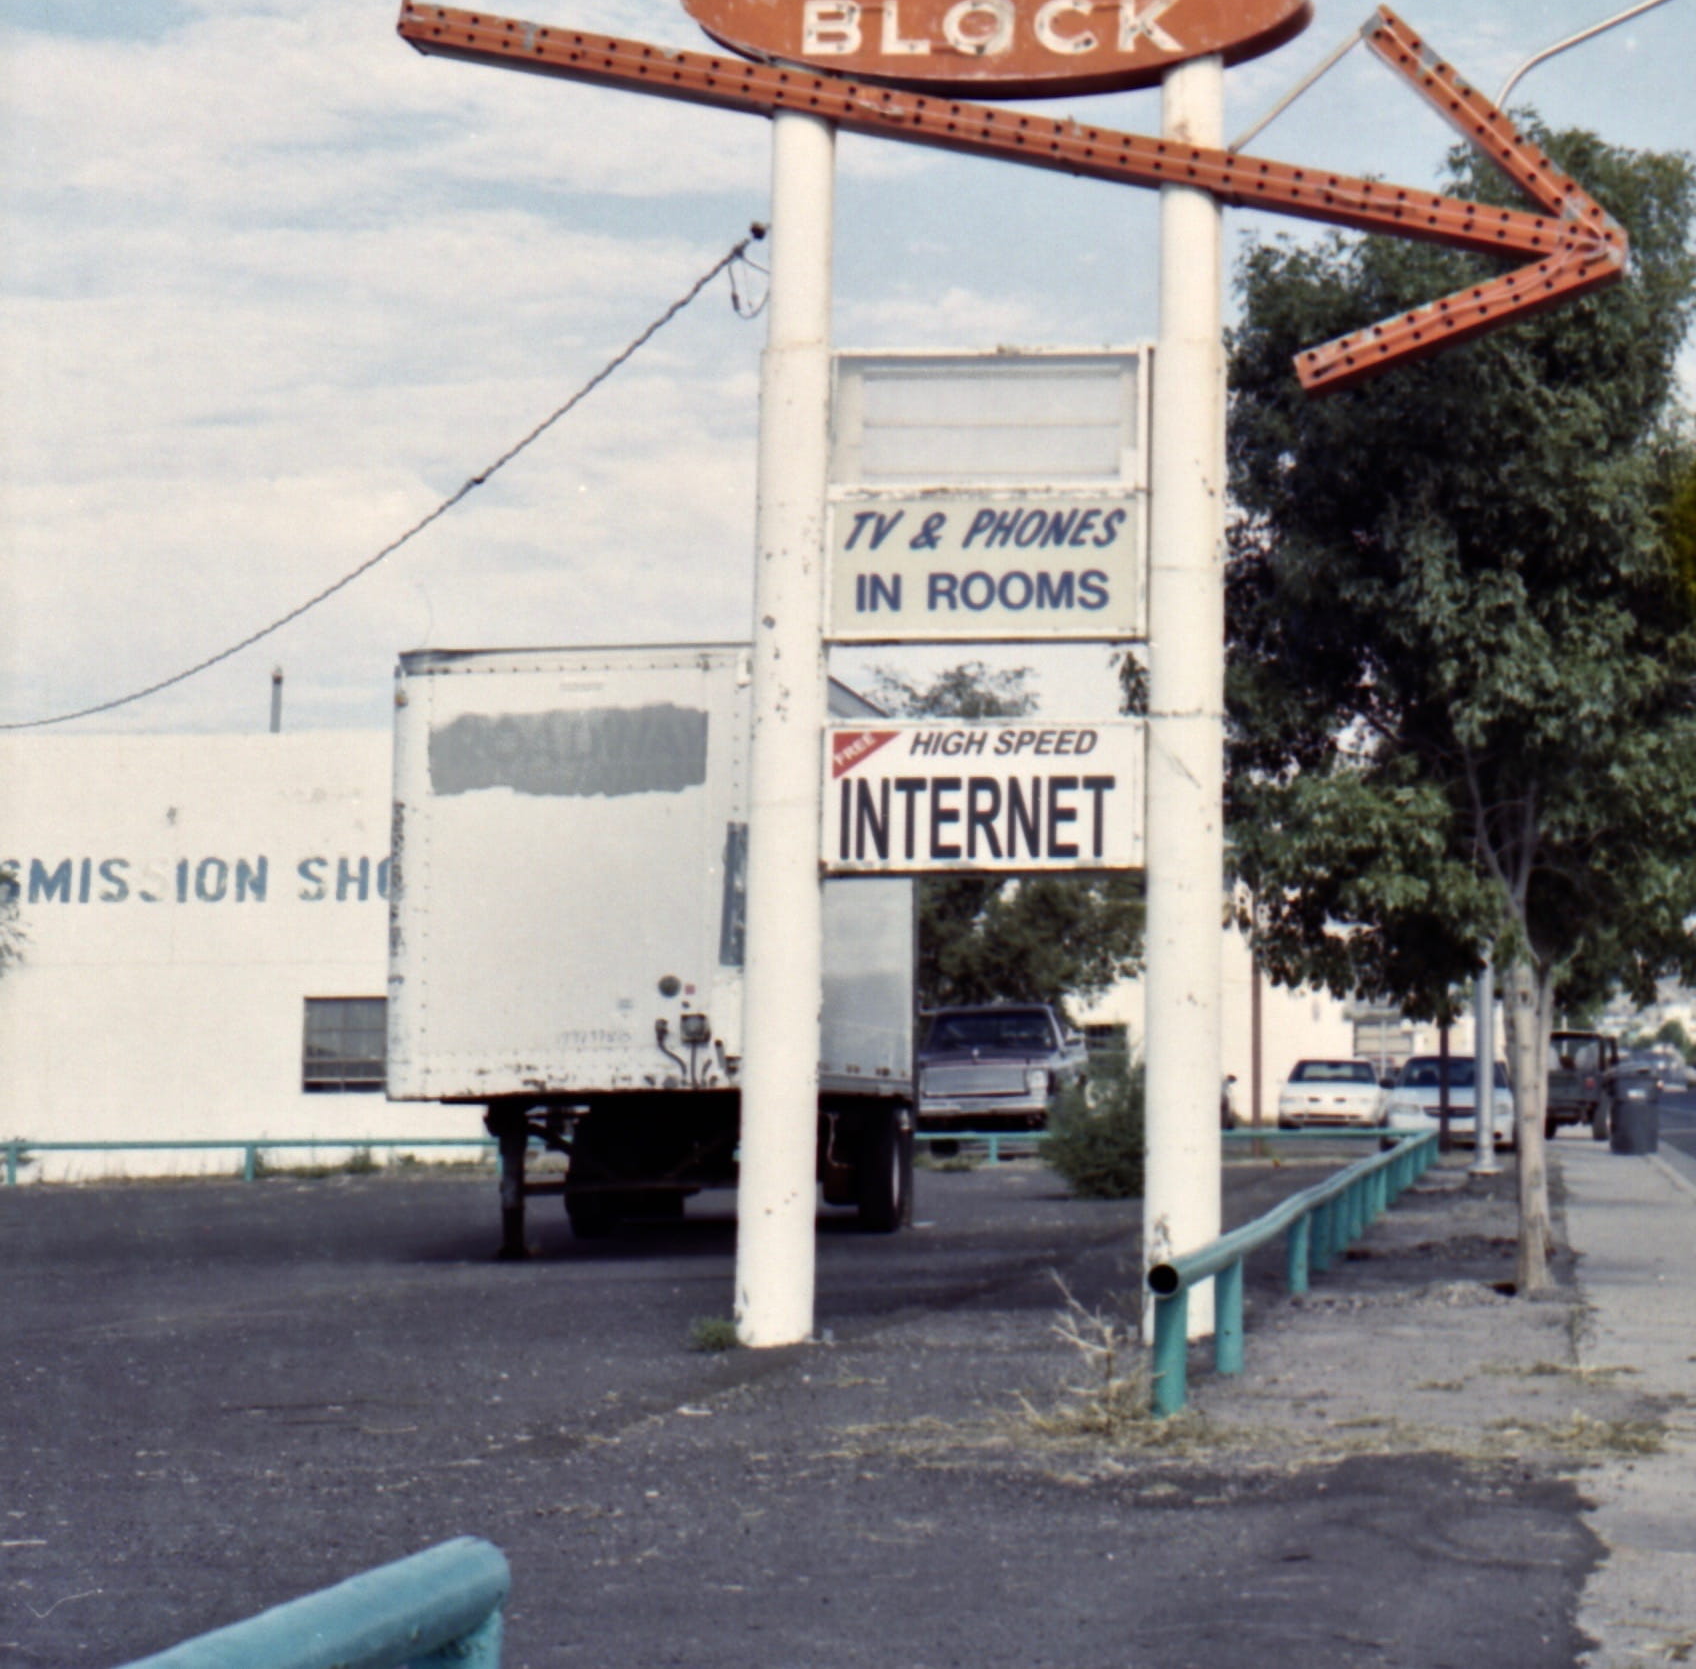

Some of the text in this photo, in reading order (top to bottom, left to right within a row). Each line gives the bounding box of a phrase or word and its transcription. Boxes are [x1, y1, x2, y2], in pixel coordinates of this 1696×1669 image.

[844, 508, 1127, 550] TV & PHONES
[855, 570, 1109, 612] IN ROOMS
[834, 731, 877, 767] FREE
[909, 729, 1098, 757] HIGH SPEED
[839, 775, 1116, 860] INTERNET
[0, 855, 269, 904] SMISION
